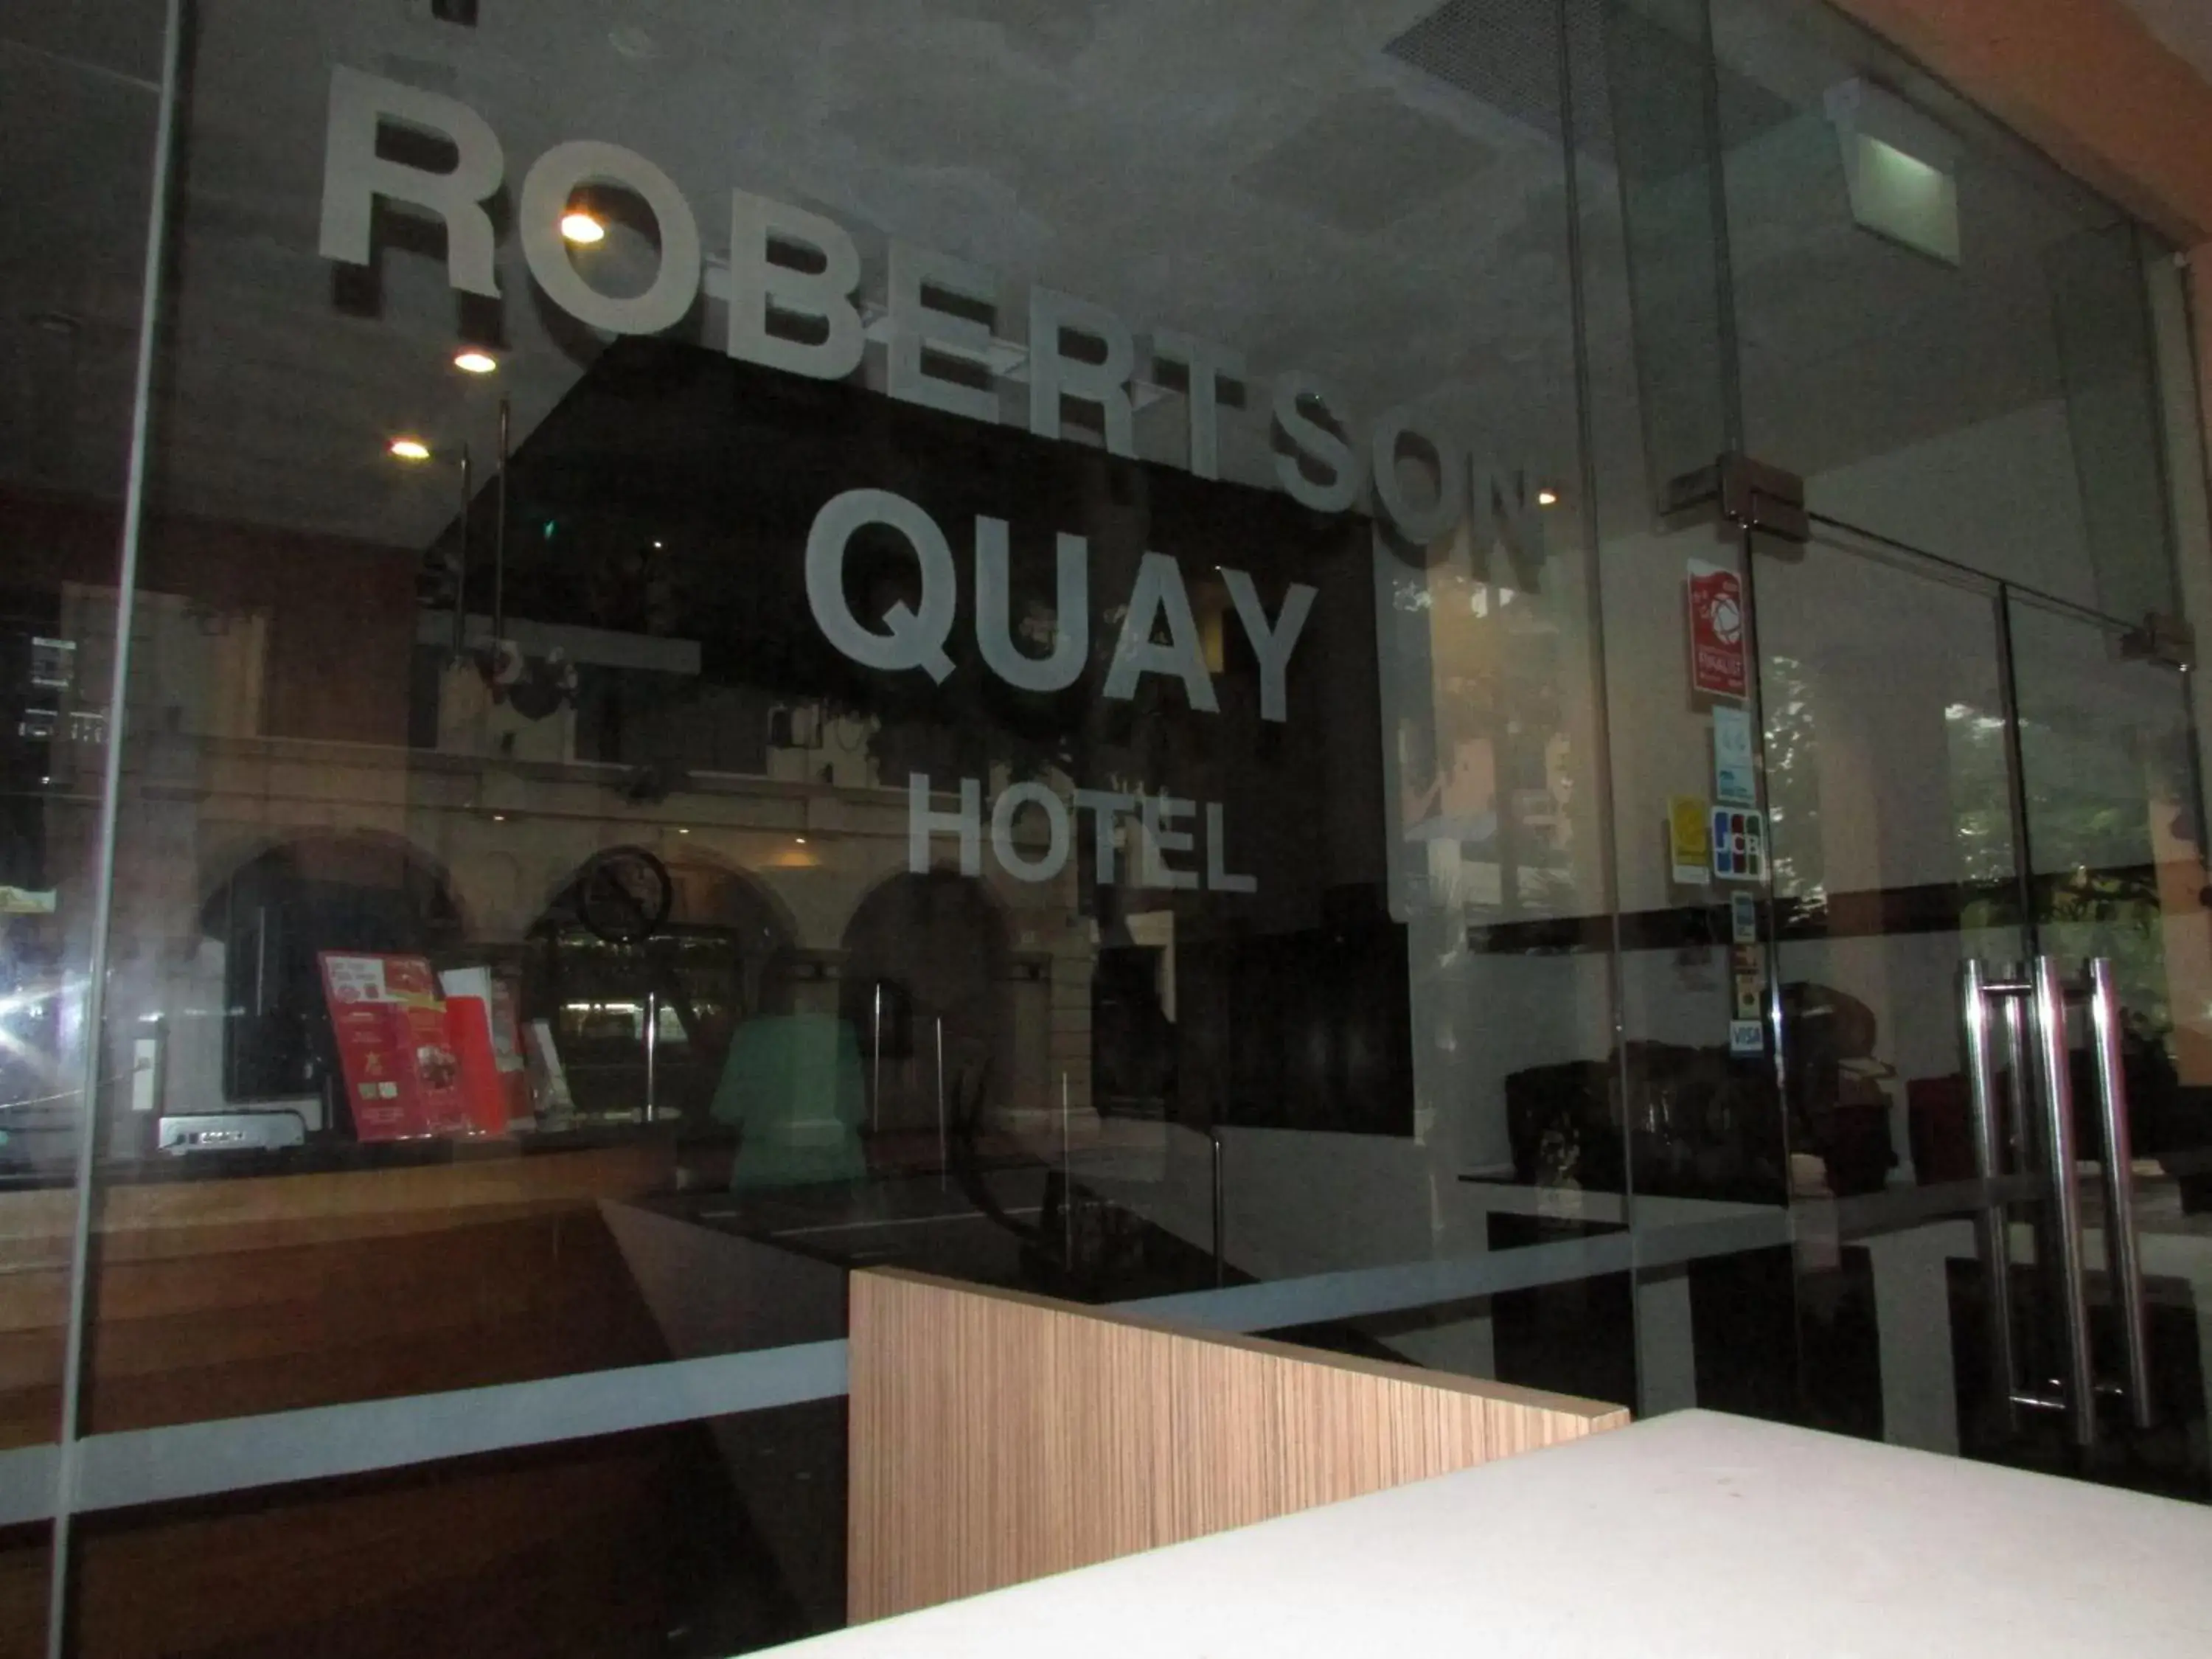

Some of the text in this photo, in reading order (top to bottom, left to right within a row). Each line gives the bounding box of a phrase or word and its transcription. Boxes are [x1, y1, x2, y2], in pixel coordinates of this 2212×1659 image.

[318, 64, 1545, 565] ROBERTSON
[804, 487, 1319, 724] QUAY
[908, 772, 1258, 894] HOTEL
[1714, 832, 1759, 855] JCB
[1733, 1026, 1761, 1046] VISA
